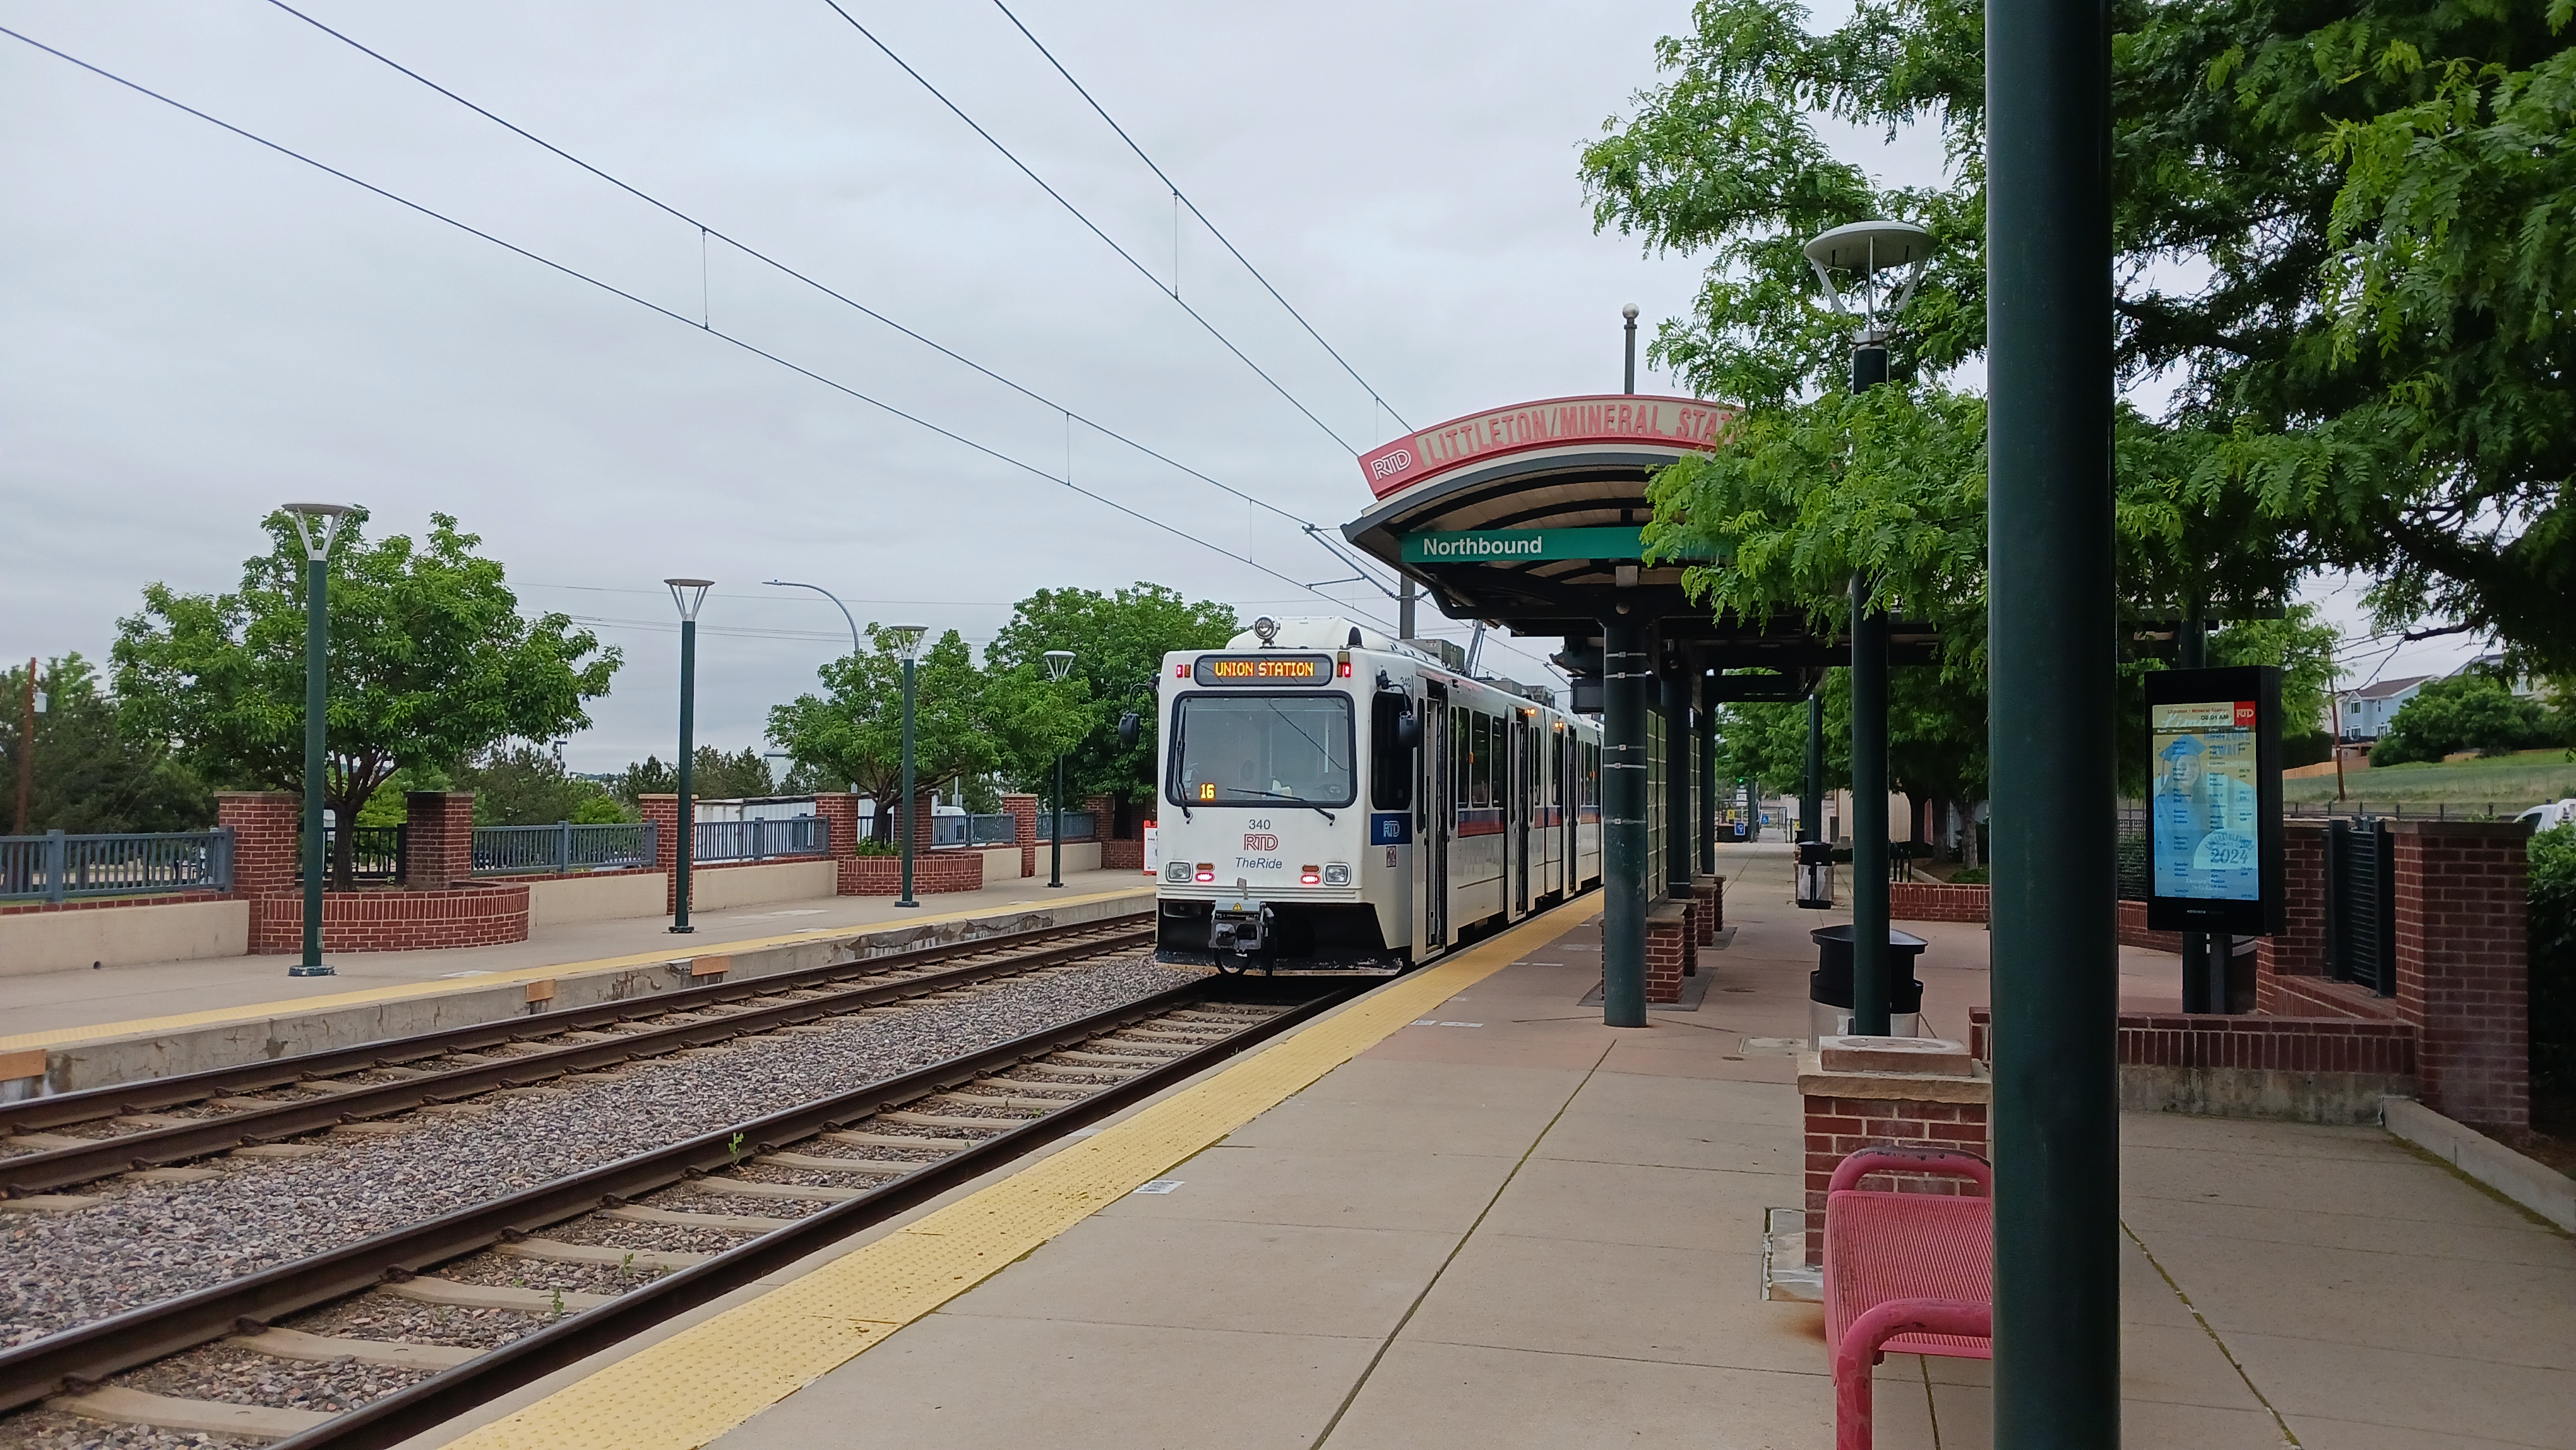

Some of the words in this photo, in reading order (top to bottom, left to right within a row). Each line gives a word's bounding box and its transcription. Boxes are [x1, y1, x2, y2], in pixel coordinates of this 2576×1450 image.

[1370, 449, 1412, 480] RTD
[1424, 404, 1662, 463] LITTLETON/MINERAL
[1423, 536, 1542, 555] Northbound
[1215, 662, 1254, 676] UNION
[1258, 662, 1314, 676] STATION
[1201, 783, 1215, 800] 16
[1248, 819, 1271, 830] 340
[1383, 820, 1400, 837] RTD
[1243, 834, 1279, 851] RTD
[1236, 857, 1282, 869] TheRide
[2210, 848, 2249, 865] 2024
